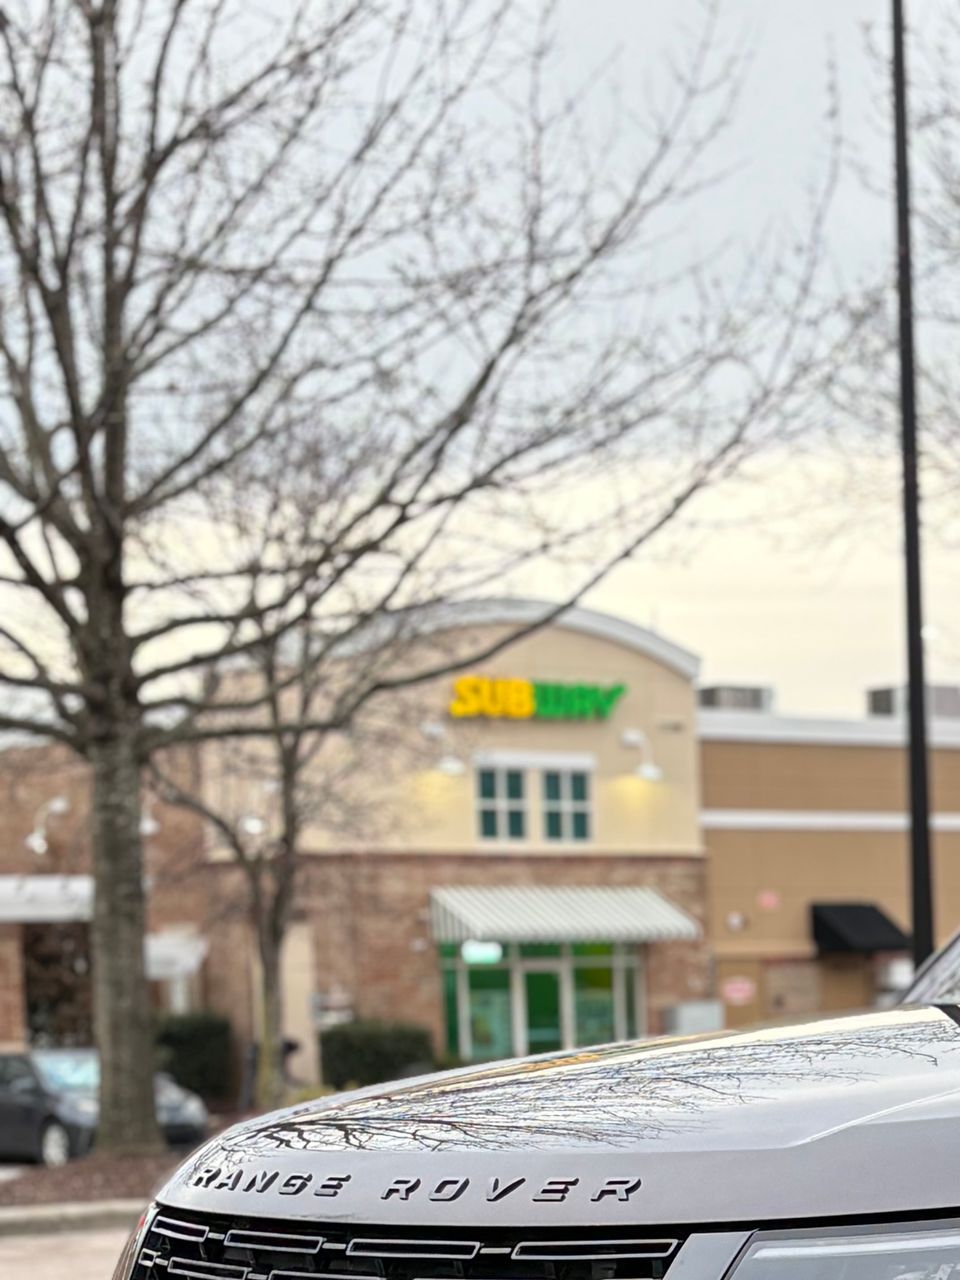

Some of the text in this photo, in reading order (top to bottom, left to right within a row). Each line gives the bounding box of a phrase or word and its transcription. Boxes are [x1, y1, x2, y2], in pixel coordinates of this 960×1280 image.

[450, 676, 626, 719] SUBWAY
[192, 1168, 642, 1202] RANGE ROVER
